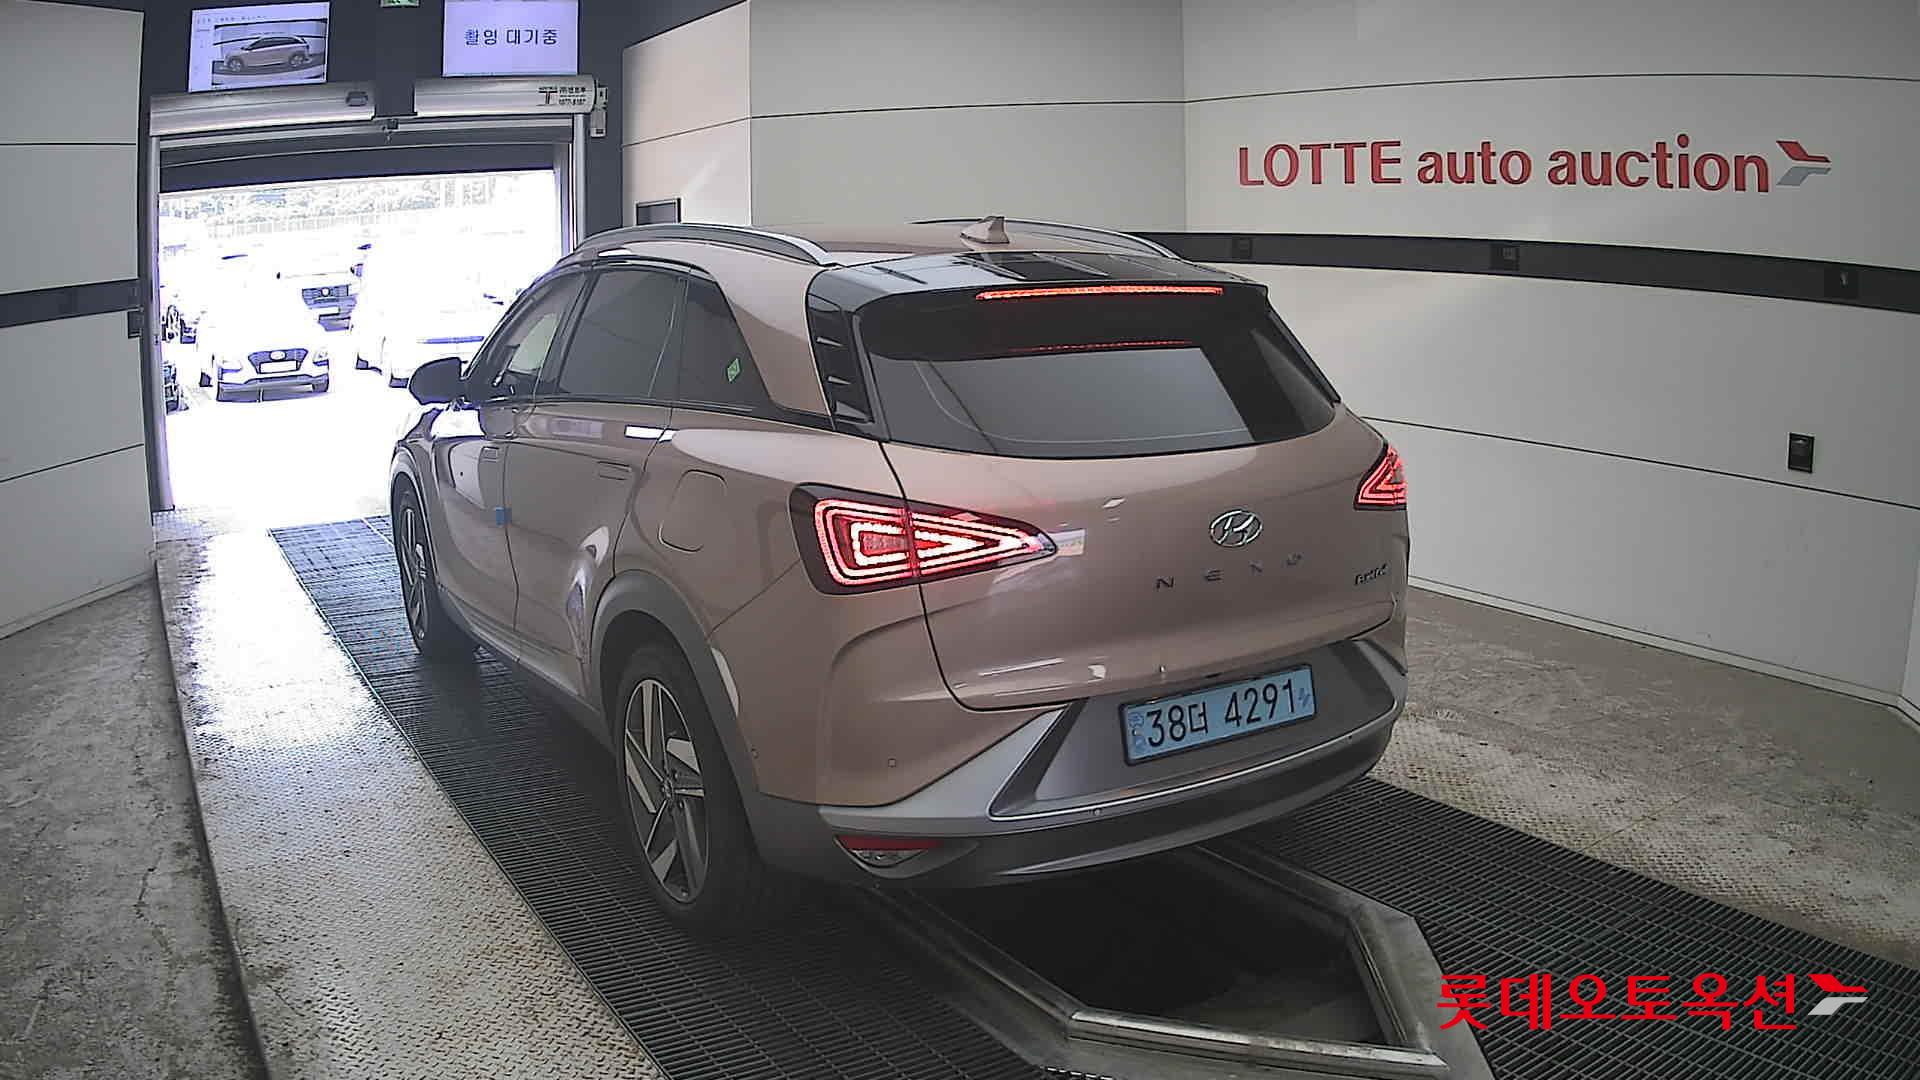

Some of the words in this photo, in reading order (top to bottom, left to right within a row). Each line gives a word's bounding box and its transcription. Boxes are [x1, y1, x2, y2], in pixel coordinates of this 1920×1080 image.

[506, 29, 558, 45] 대기중
[1238, 140, 1402, 188] LOTTE
[1416, 141, 1532, 186] auto
[1547, 132, 1770, 193] auction
[1146, 701, 1209, 748] 38더
[1225, 678, 1295, 728] 4291
